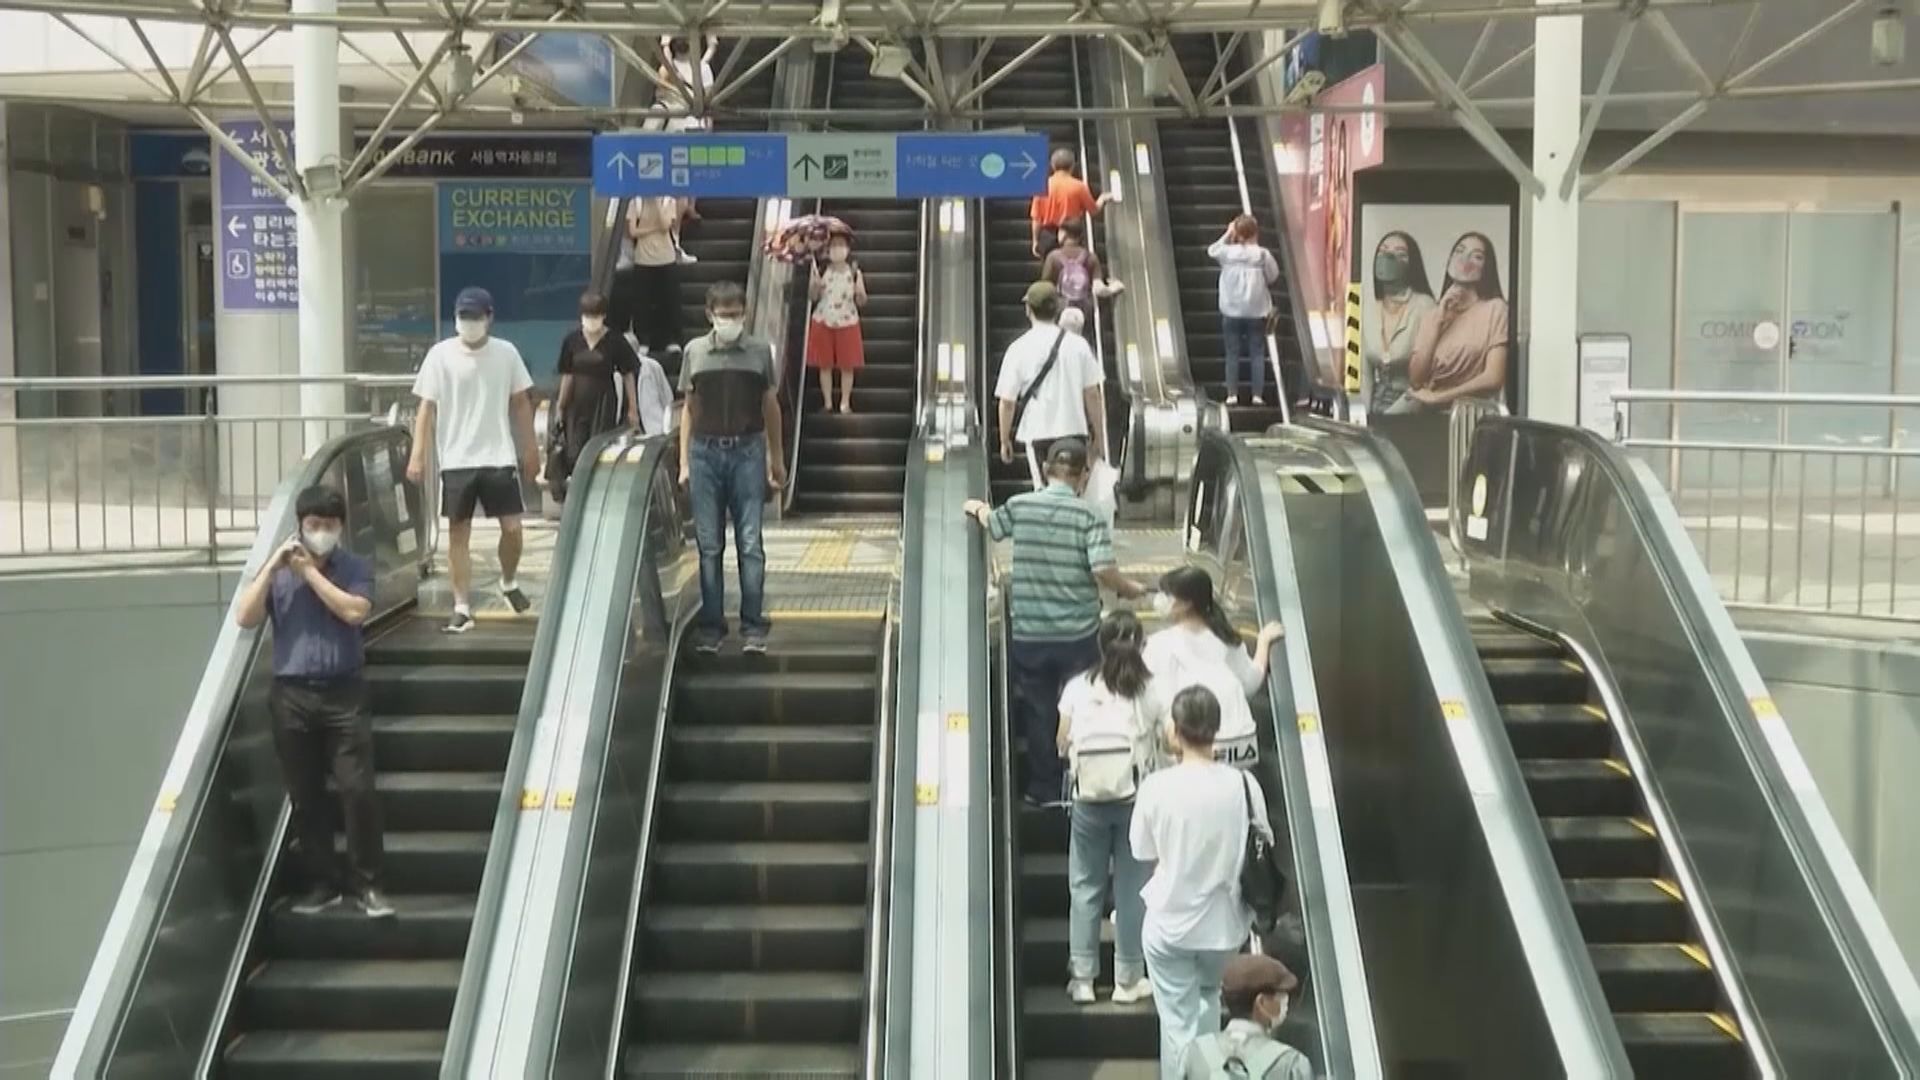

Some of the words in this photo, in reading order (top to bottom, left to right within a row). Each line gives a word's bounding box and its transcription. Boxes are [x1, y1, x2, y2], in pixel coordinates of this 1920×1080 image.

[452, 188, 577, 207] CURRENCY
[452, 209, 577, 228] EXCHANGE
[1213, 742, 1257, 763] FILA
